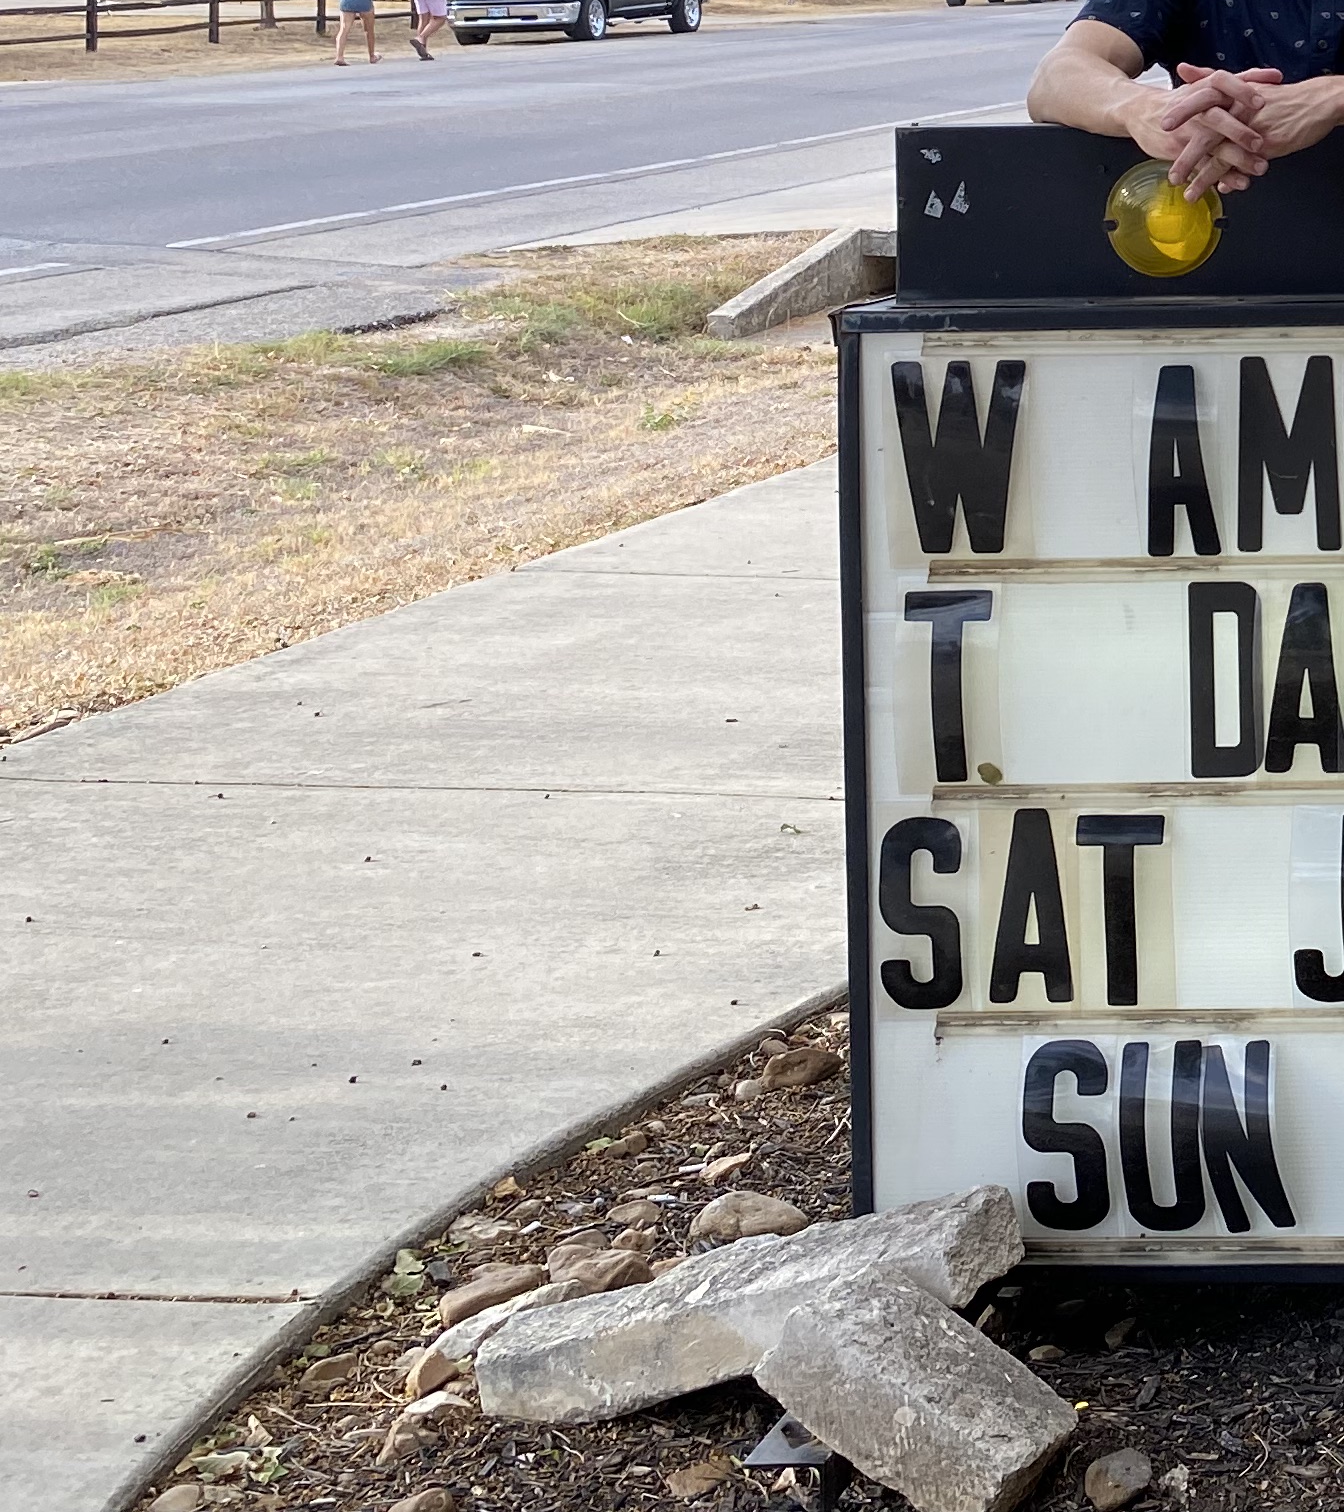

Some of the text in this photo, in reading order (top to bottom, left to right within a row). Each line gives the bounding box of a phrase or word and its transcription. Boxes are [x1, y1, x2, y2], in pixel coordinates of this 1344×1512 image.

[891, 360, 1026, 554] W
[879, 808, 1165, 1009] SAT
[1022, 1040, 1296, 1233] SUN
